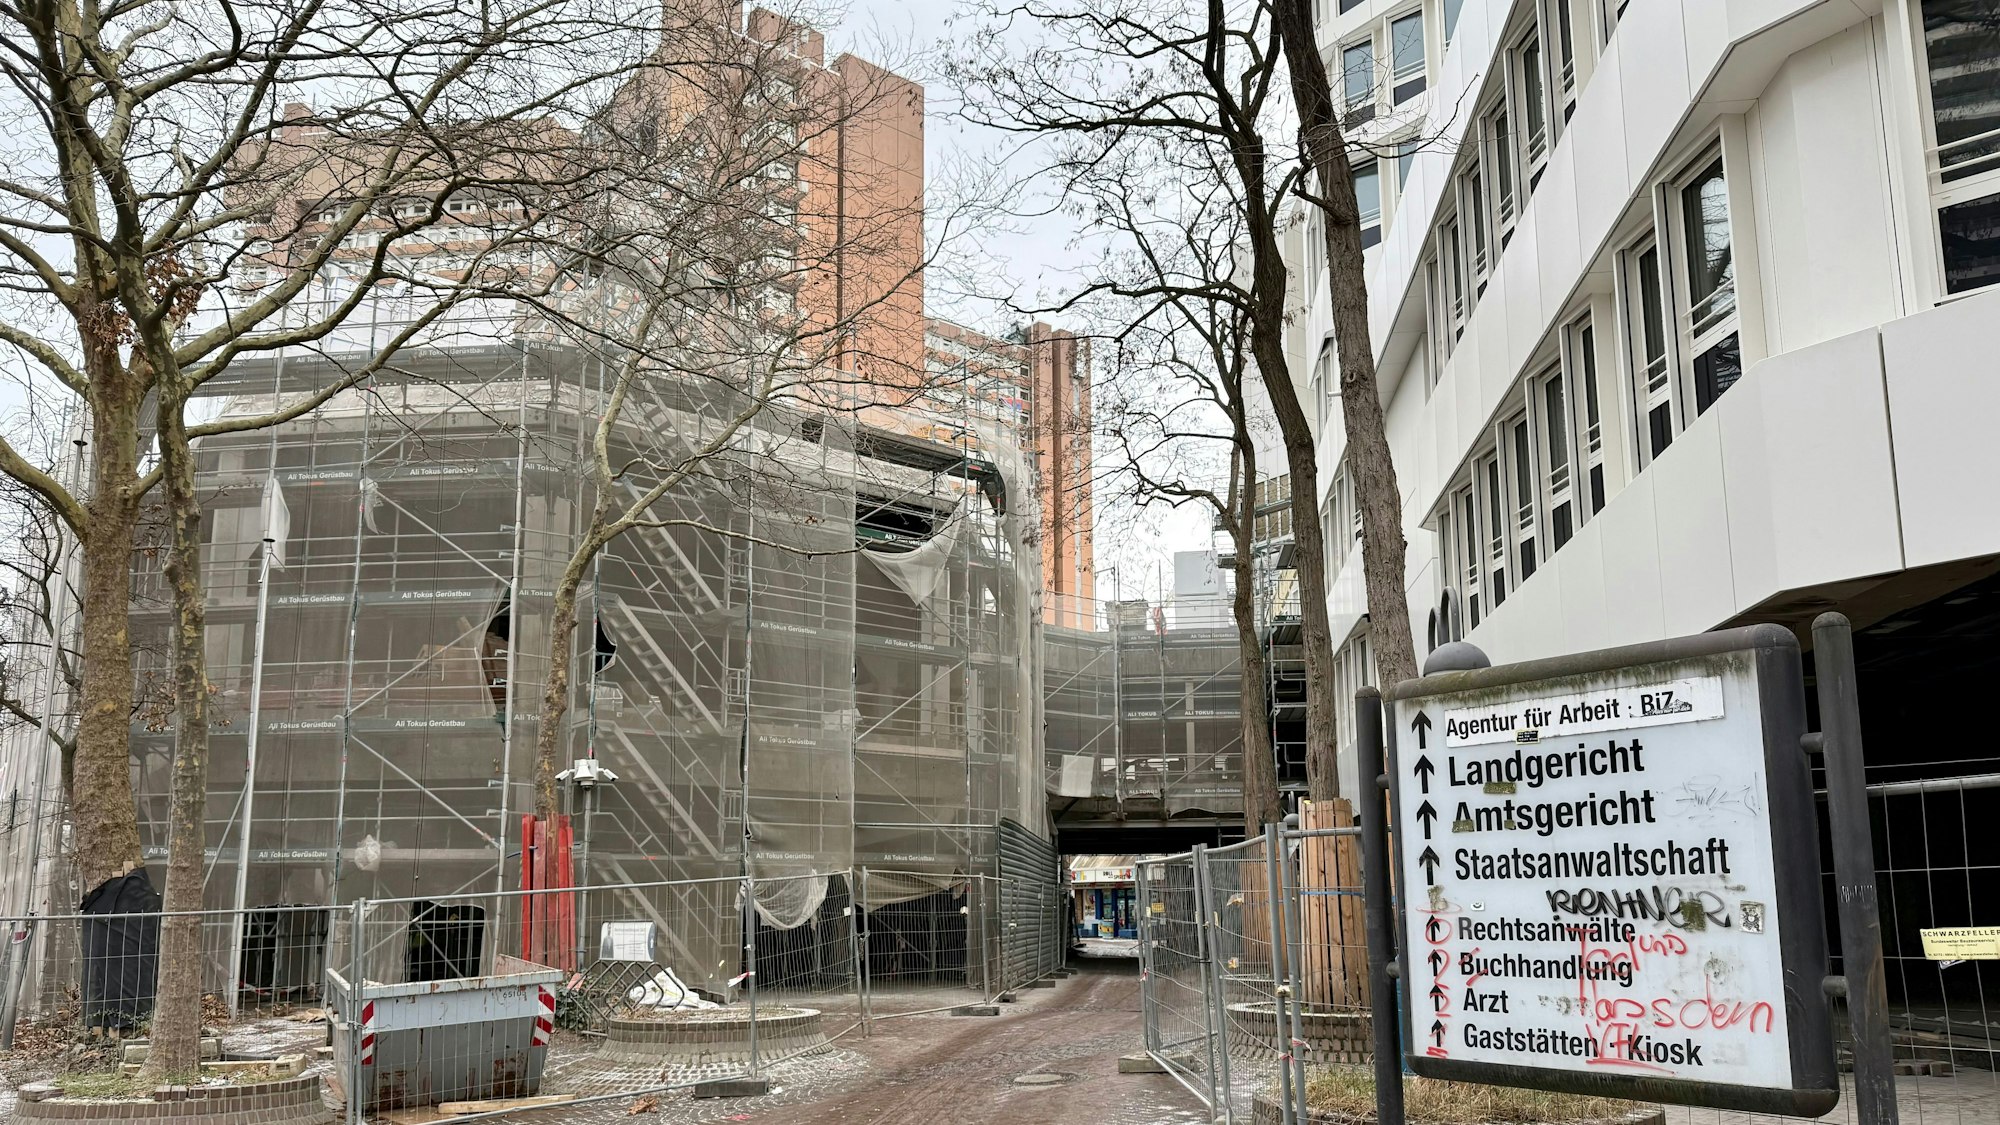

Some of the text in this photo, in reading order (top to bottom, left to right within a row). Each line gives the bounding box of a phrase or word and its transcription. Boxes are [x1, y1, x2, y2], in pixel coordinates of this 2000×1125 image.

[524, 462, 535, 470] Ali
[319, 471, 354, 479] Gerüstbau
[409, 468, 420, 476] Ali
[420, 467, 441, 475] Tokus
[435, 590, 472, 598] Gerüstbau
[530, 589, 553, 597] Tokus
[310, 595, 345, 603] Gerüstbau
[760, 621, 769, 629] Ali
[769, 623, 787, 631] Tokus
[428, 719, 466, 727] Gerüstbau
[1446, 713, 1518, 740] Agentur
[1523, 707, 1552, 729] für
[1559, 698, 1620, 725] Arbeit
[300, 721, 336, 729] Gerüstbau
[1448, 738, 1645, 789] Landgericht
[1453, 789, 1657, 837] Amtsgericht
[1454, 837, 1731, 881] Staatsanwaltschaft
[1458, 916, 1637, 944] Rechtsanwälte
[1460, 952, 1634, 987] Buchhandlung
[1463, 987, 1509, 1014] Arzt
[1464, 1023, 1704, 1067] Gaststätten Kiosk
